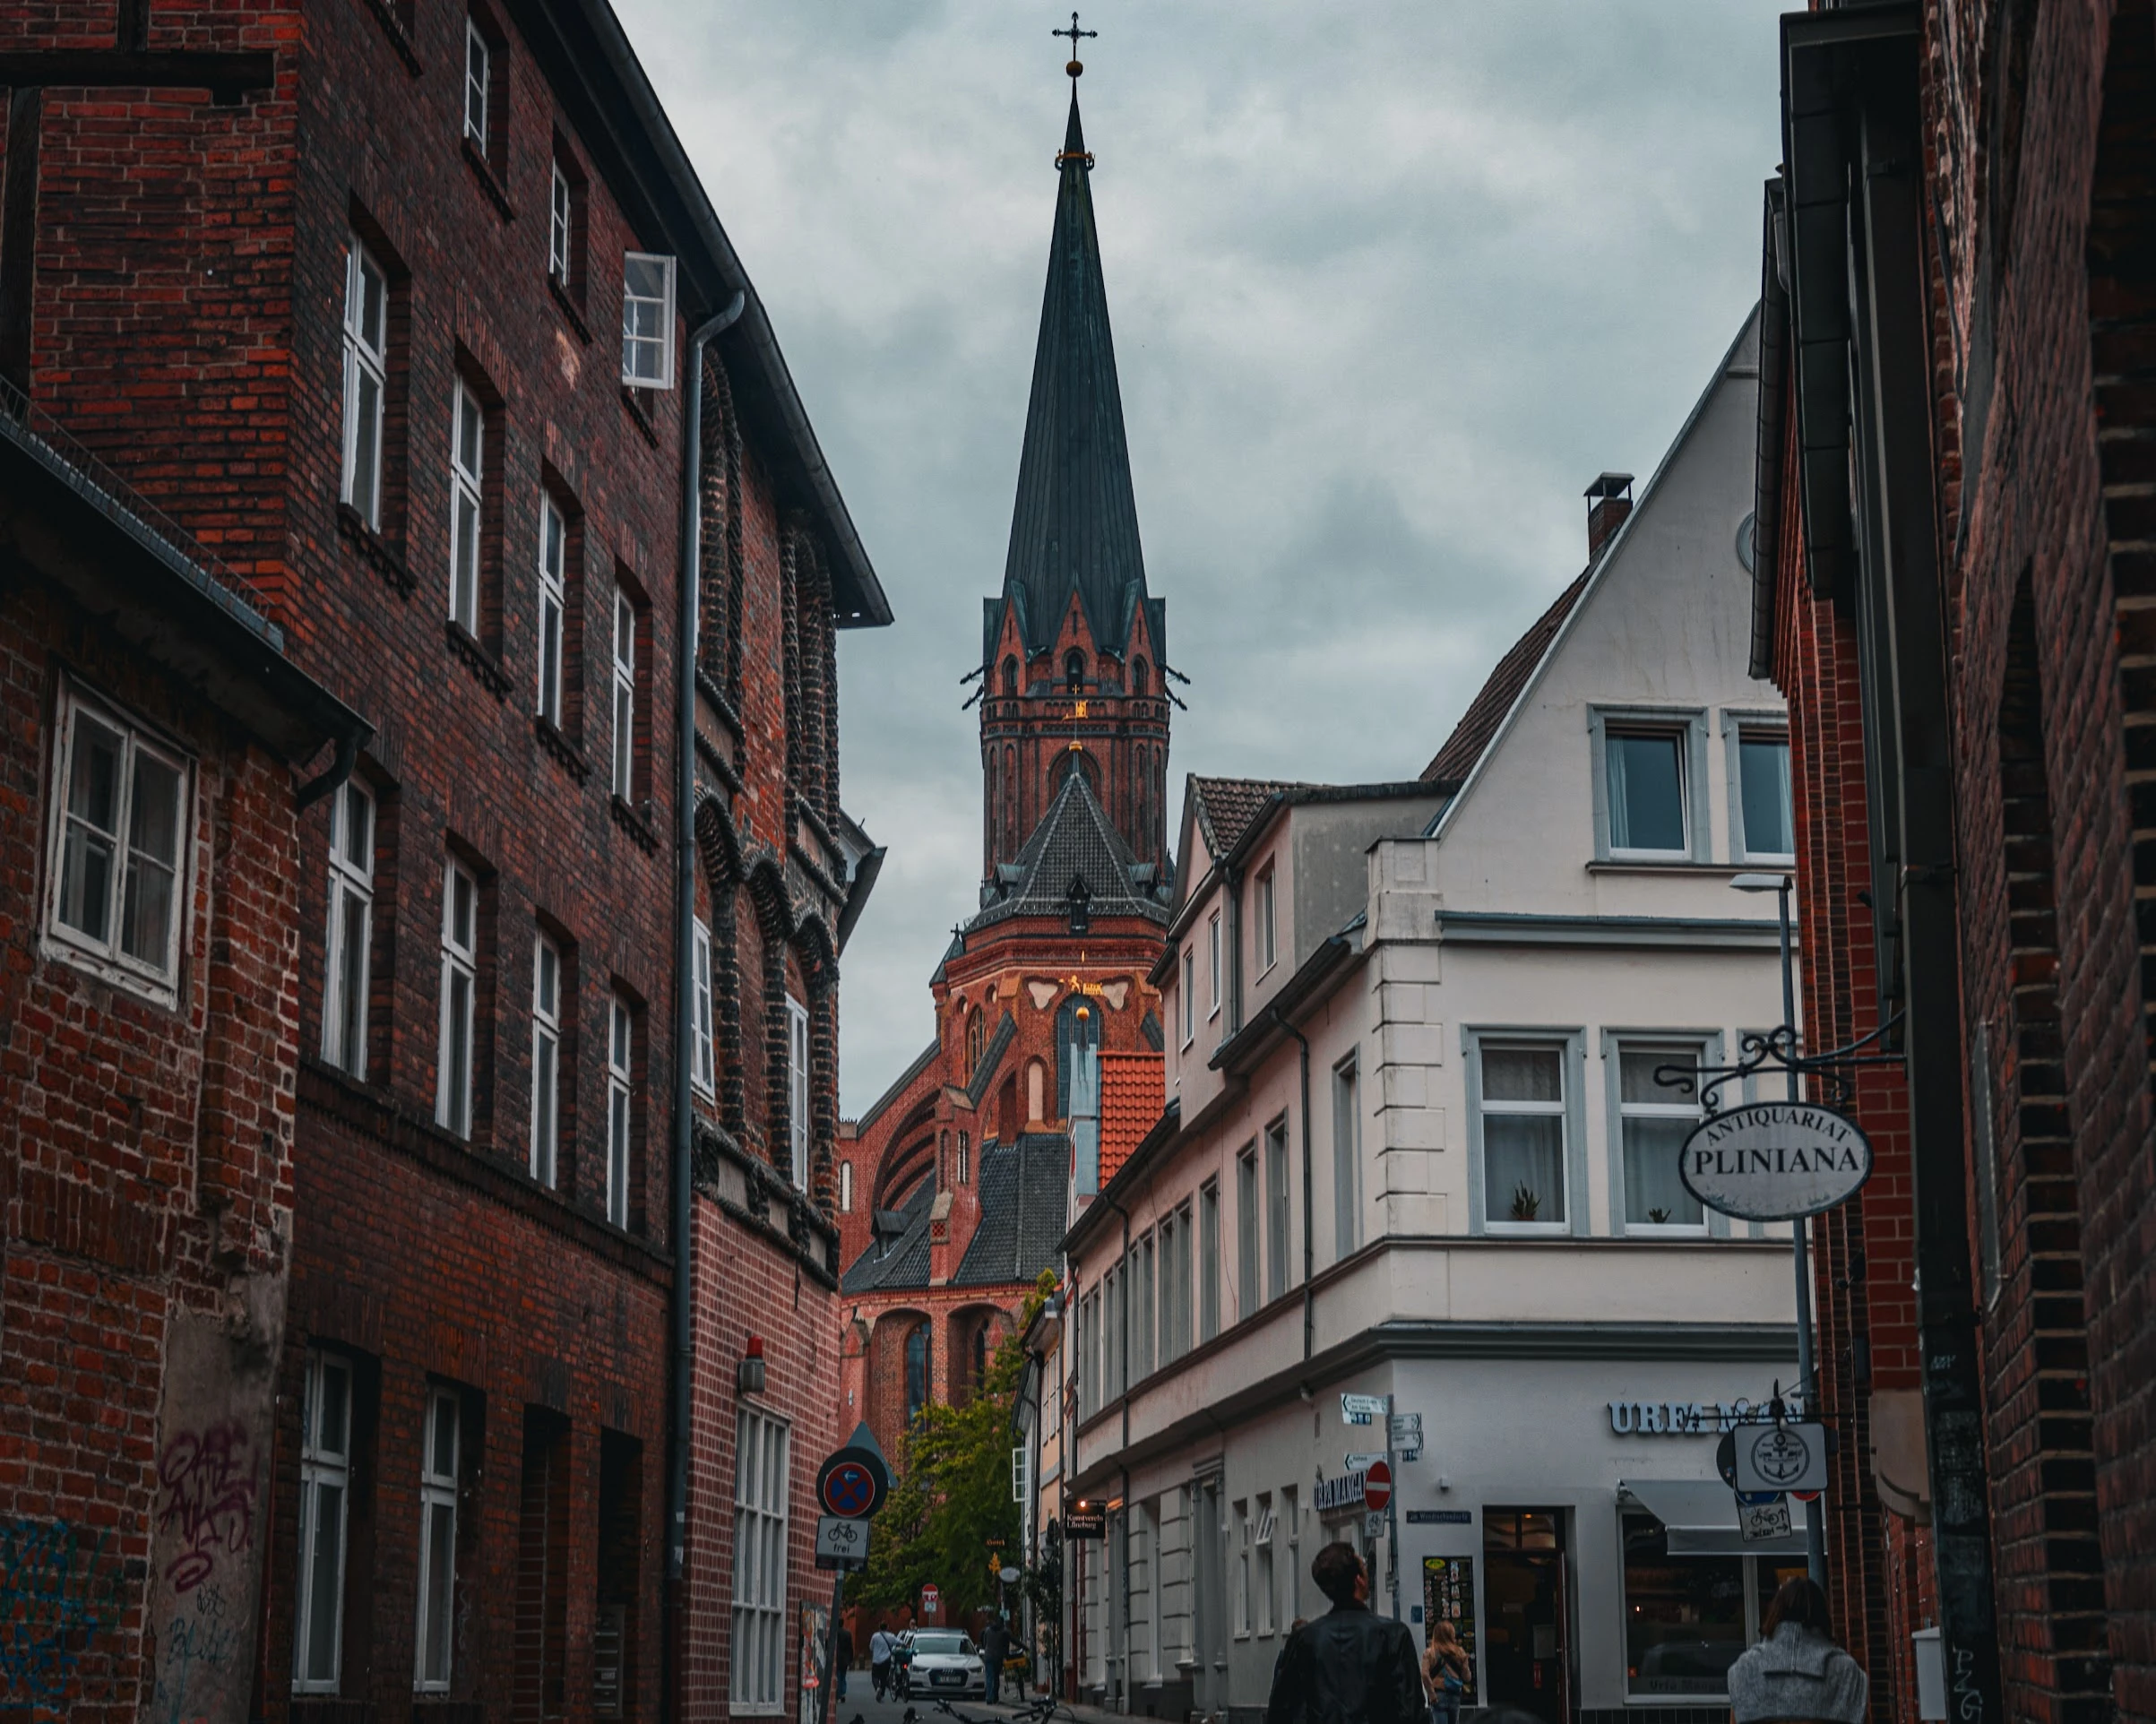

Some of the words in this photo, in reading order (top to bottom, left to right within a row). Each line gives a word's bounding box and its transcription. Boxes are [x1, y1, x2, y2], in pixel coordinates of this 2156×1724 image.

[1705, 1108, 1852, 1147] ANTIQUARIAT
[1693, 1147, 1861, 1176] PLINIANA
[1333, 1470, 1366, 1507] MANGA
[1066, 1513, 1104, 1522] Kunstverein
[833, 1542, 850, 1555] frei
